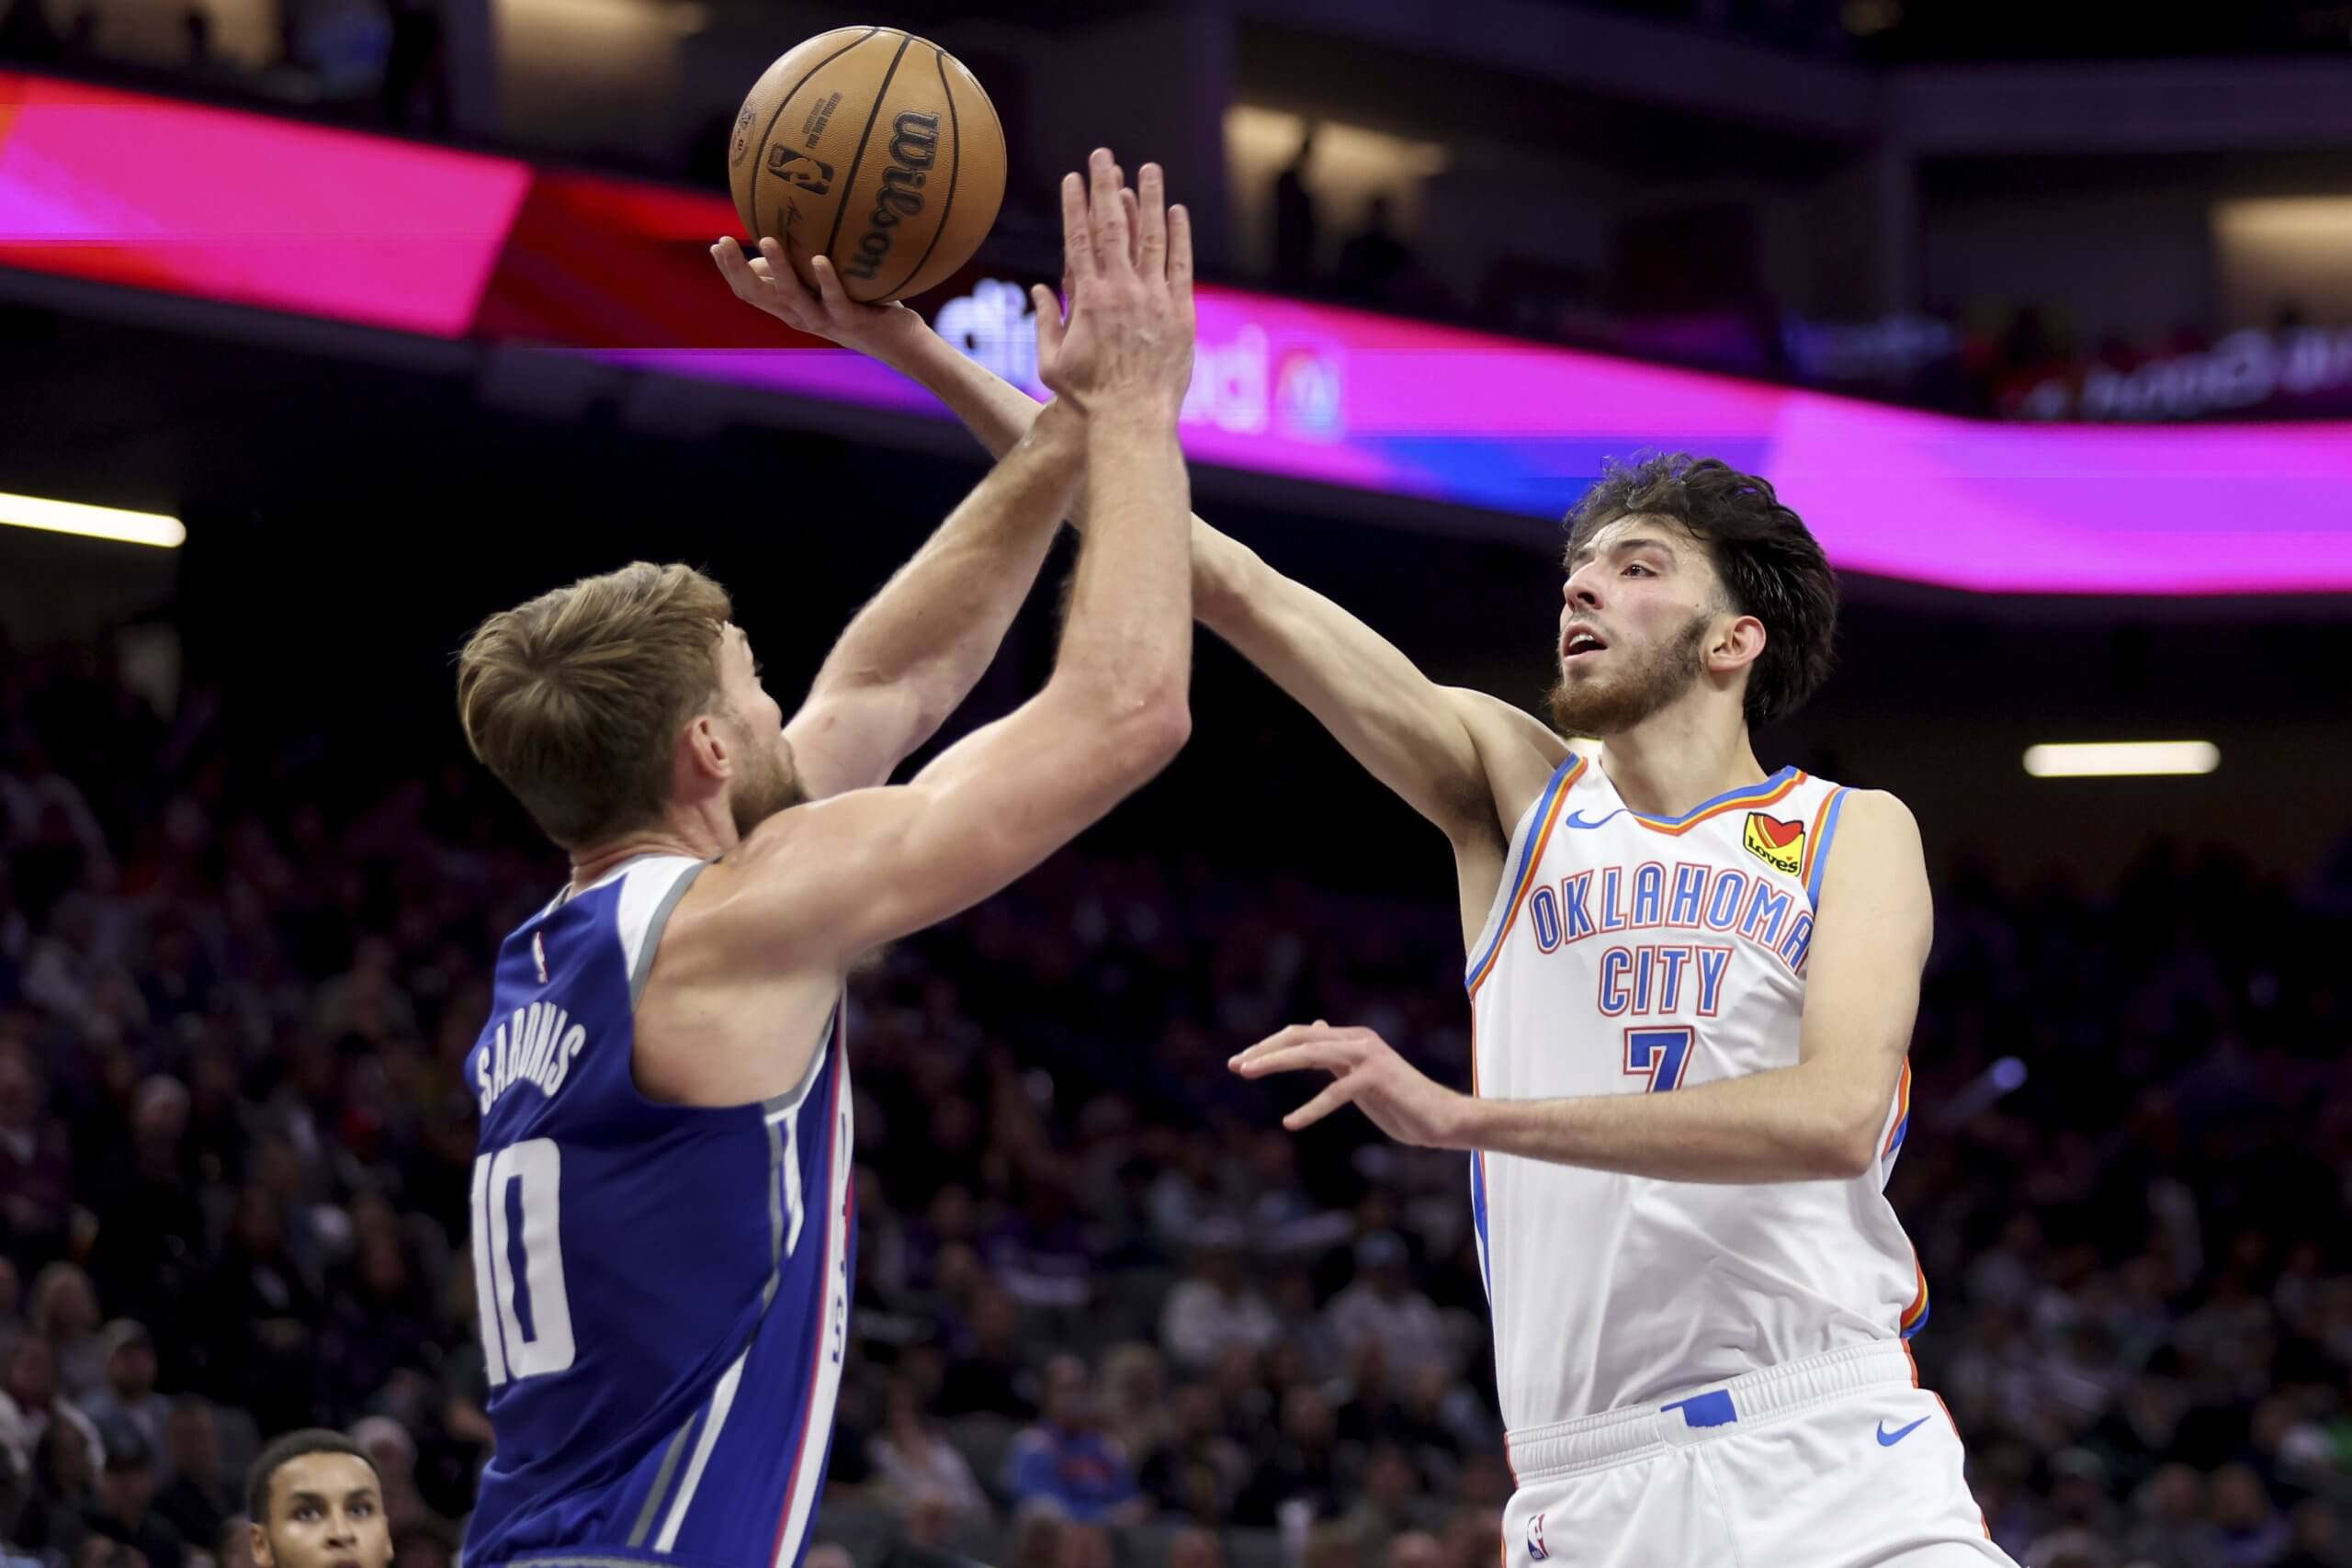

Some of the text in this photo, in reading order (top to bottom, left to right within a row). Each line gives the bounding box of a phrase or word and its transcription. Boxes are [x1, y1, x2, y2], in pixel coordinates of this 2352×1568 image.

[844, 110, 941, 280] Wilson
[1529, 862, 1814, 976] OKLAHOMA
[1598, 944, 1734, 1018] CITY
[476, 1000, 587, 1117] SABONIS
[1623, 1025, 1695, 1094] 7
[470, 1136, 576, 1386] 10
